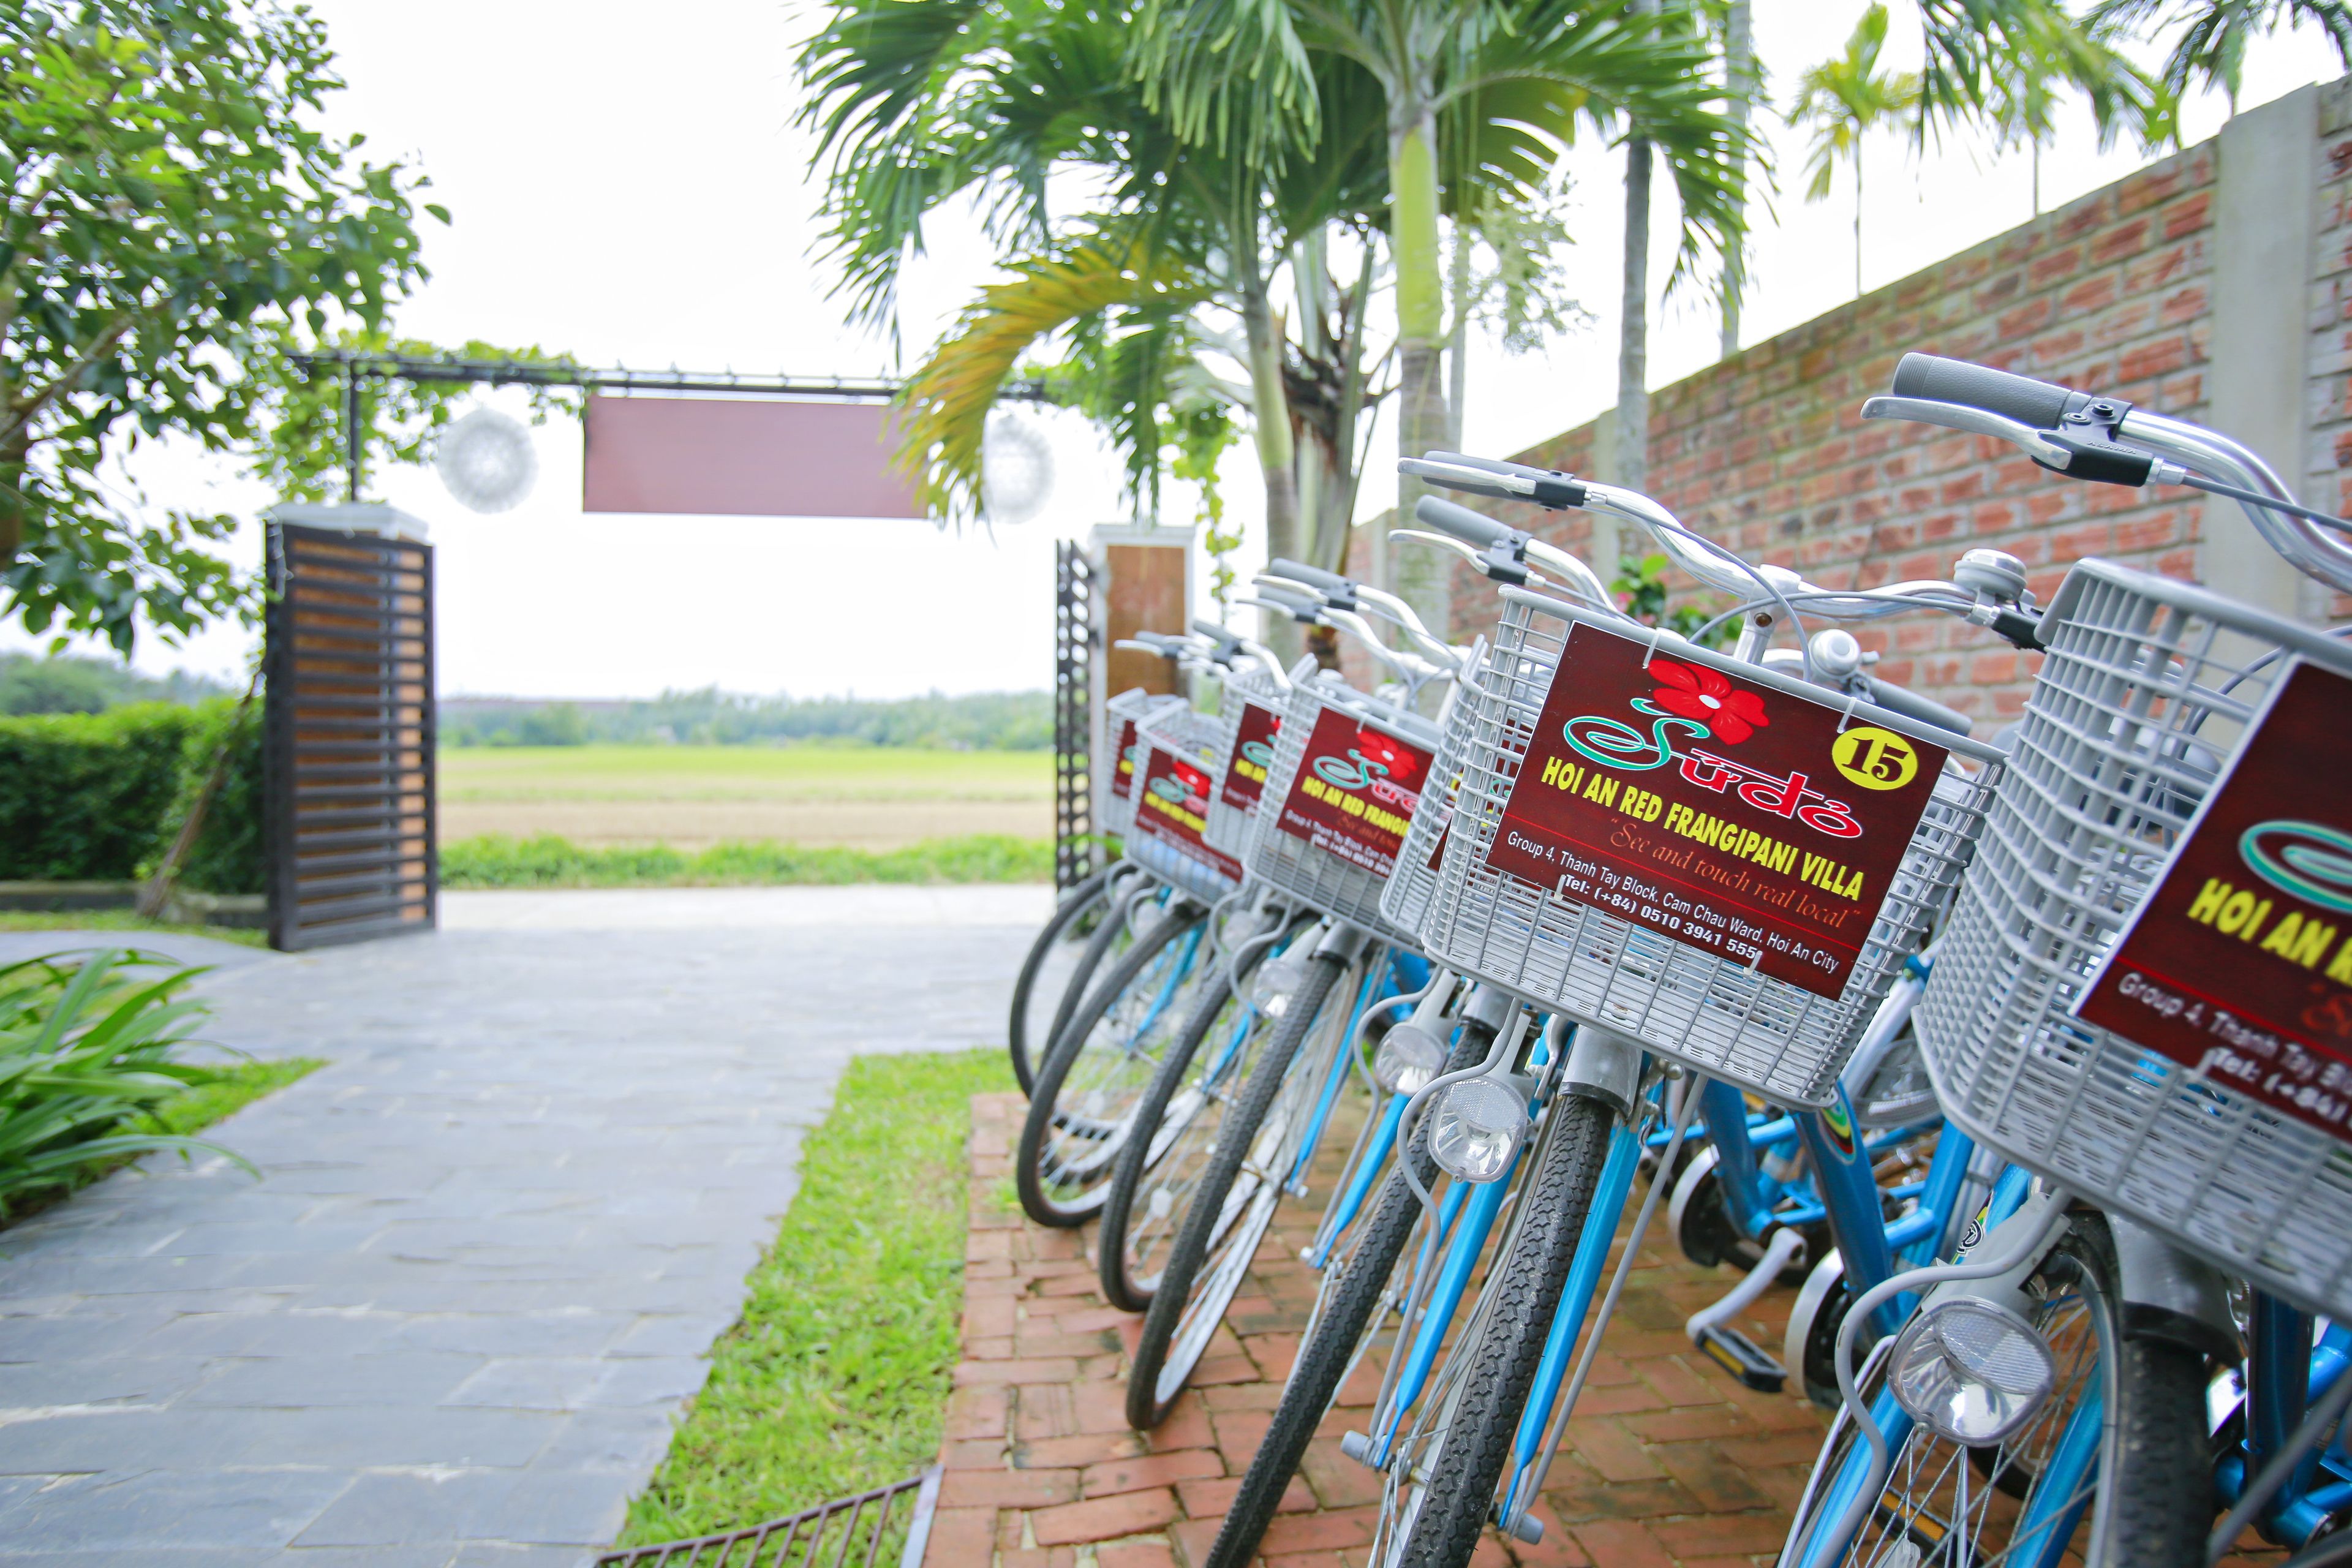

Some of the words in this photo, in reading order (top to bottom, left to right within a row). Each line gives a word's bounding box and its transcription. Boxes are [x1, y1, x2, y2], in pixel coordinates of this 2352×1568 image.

[1322, 786, 1344, 808] AN
[1340, 793, 1365, 817] RED
[1841, 737, 1910, 782] 15
[1540, 756, 1585, 794] HOI
[1582, 773, 1620, 807] AN
[1619, 785, 1663, 822] RED
[1663, 802, 1799, 875] FRANGIPANI
[1801, 852, 1864, 902] VILLA
[1507, 831, 1543, 858] Group
[1560, 851, 1596, 877] Thanh
[1600, 866, 1621, 889] Tay
[1663, 892, 1691, 914] Cam
[1694, 904, 1727, 928] Chau
[1766, 932, 1792, 953] Hoi
[1790, 944, 1809, 961] An
[1812, 950, 1840, 974] City
[1564, 873, 1591, 894] Tel:
[1594, 887, 1637, 914] (+84)
[1640, 905, 1680, 929] 0510
[1683, 922, 1722, 946] 3941
[1726, 938, 1758, 959] 555
[1652, 846, 1694, 869] and
[1694, 859, 1750, 892] touch
[1754, 883, 1796, 908] real
[2187, 876, 2274, 942] HOI
[2258, 910, 2338, 970] AN
[2118, 971, 2185, 1018] Group
[2208, 1011, 2278, 1059] Thanh
[2278, 1042, 2320, 1082] Tay
